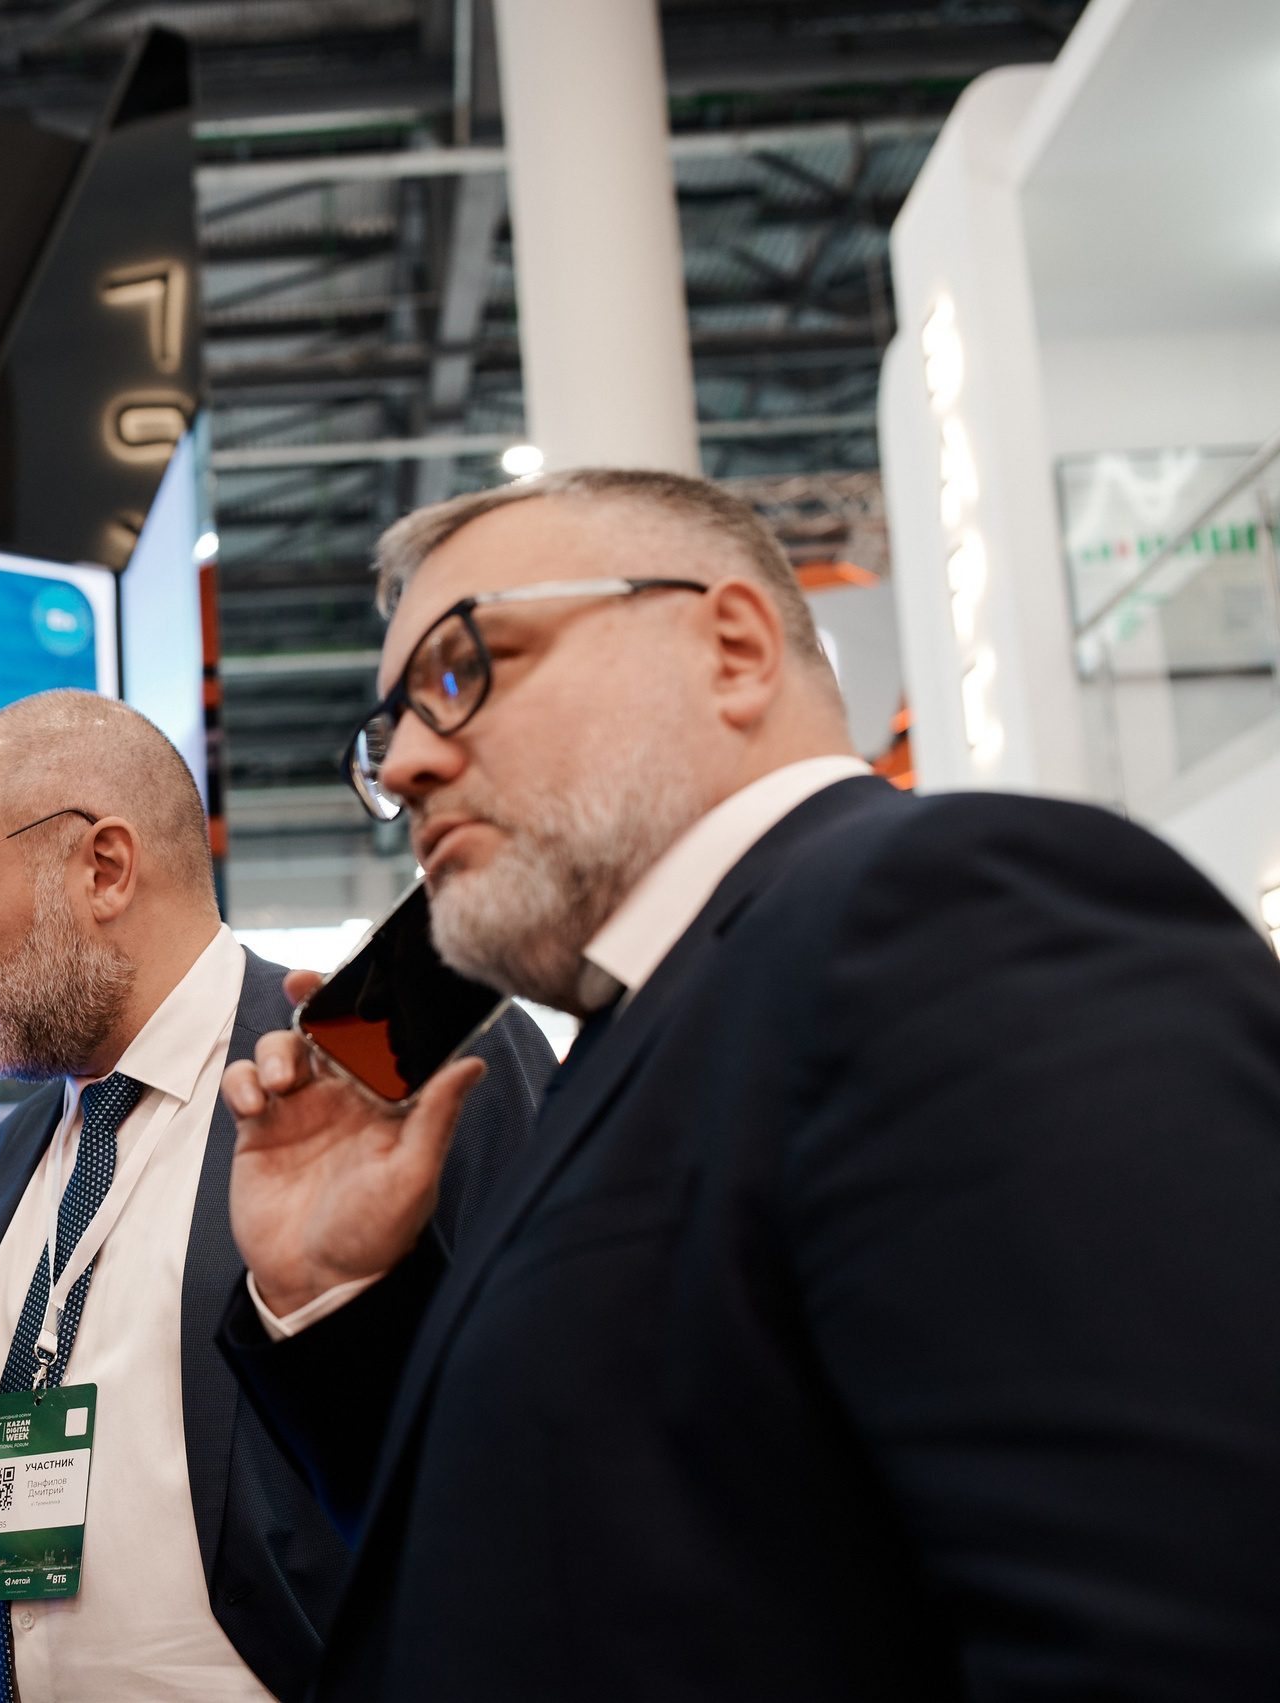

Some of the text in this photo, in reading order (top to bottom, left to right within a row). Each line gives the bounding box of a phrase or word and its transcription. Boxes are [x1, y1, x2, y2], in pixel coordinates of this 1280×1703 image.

[6, 1433, 28, 1441] WEEK
[25, 1458, 74, 1471] УЧАСТНИК
[27, 1478, 67, 1489] Панфилов
[28, 1486, 64, 1498] Дмитрий
[53, 1575, 66, 1583] ВТБ
